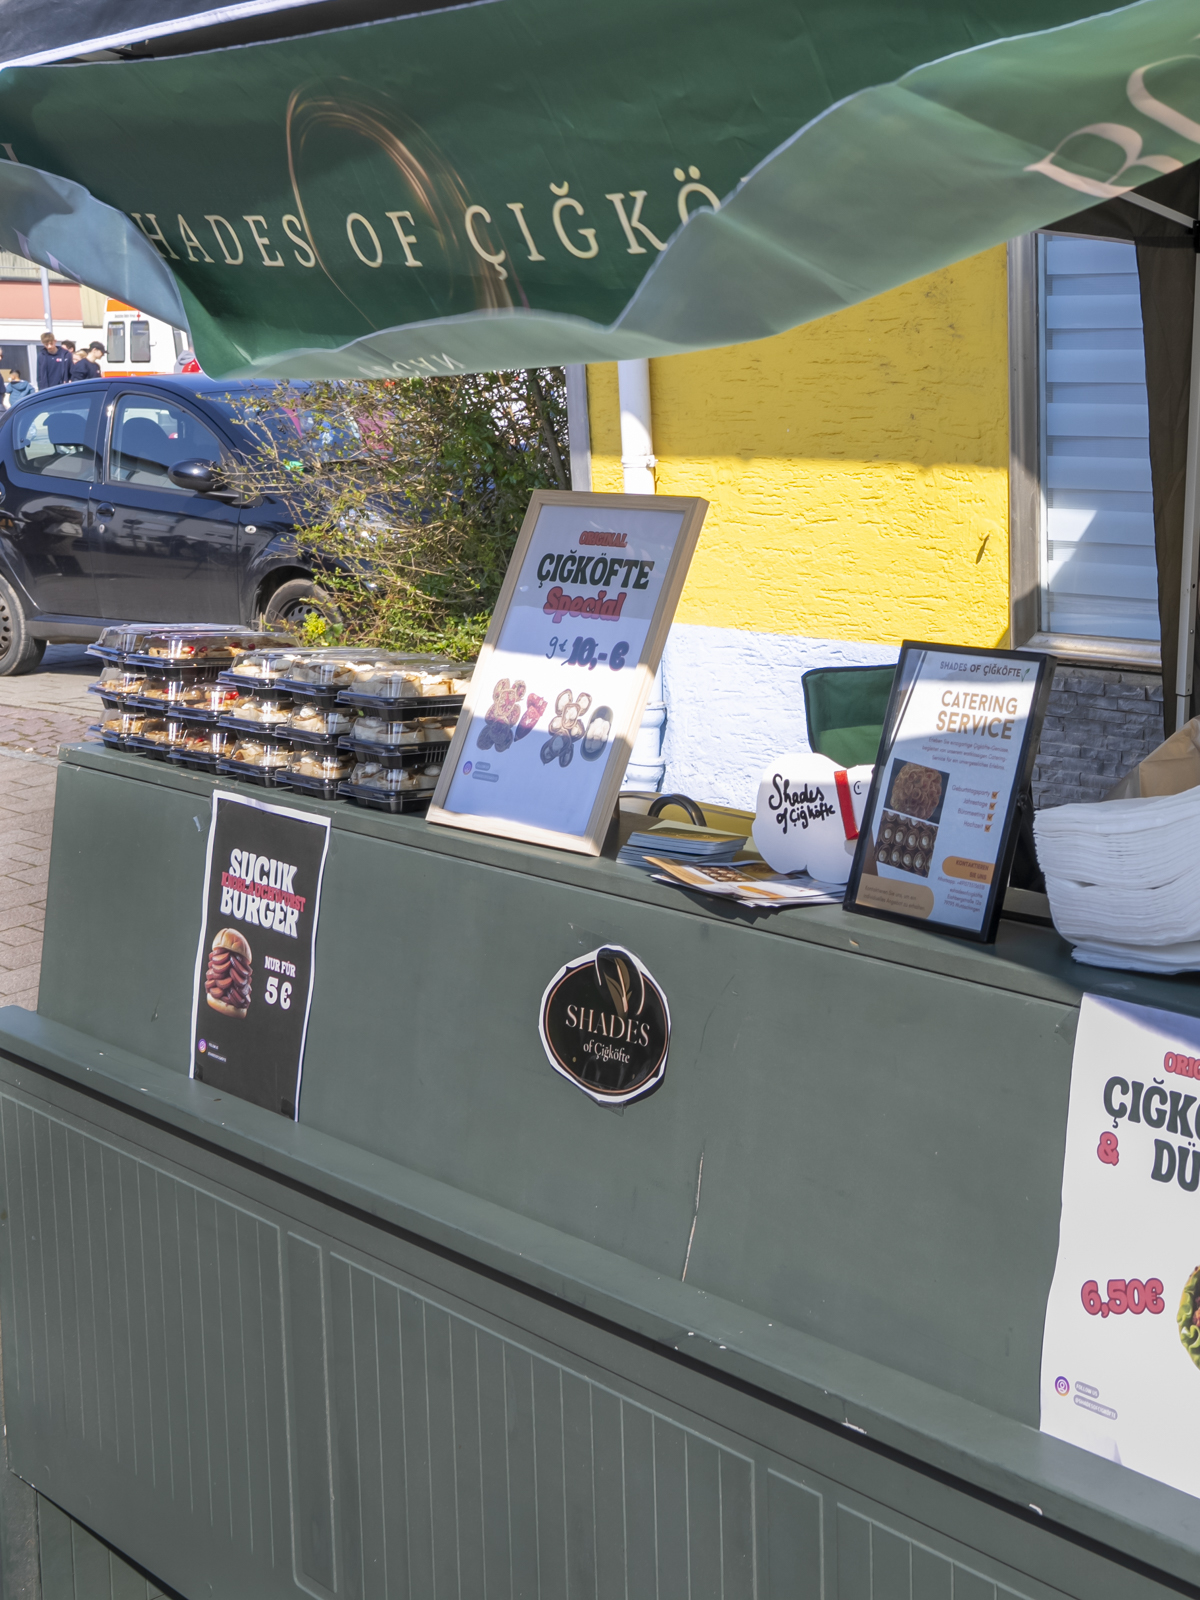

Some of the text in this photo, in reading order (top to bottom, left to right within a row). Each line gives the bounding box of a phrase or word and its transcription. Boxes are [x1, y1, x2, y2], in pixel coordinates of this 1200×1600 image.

[131, 165, 722, 280] HADES OF ÇIĞKÖ
[579, 531, 628, 547] ORIGINAL
[537, 550, 655, 590] ÇIĞKÖFTE
[543, 586, 627, 623] Special
[940, 661, 968, 672] SHADES
[969, 663, 982, 673] OF
[941, 690, 1018, 715] CATERING
[936, 710, 1015, 740] SERVICE
[768, 773, 825, 810] Shades
[776, 806, 788, 834] of
[229, 848, 298, 896] SUCUK
[221, 872, 306, 913] KNOBLAUCHWURST
[220, 886, 299, 939] BURGER
[264, 955, 296, 978] NUR FÜR
[565, 1004, 650, 1047] SHADES
[583, 1039, 594, 1052] of
[1097, 1131, 1120, 1167] &
[1080, 1277, 1166, 1319] 6,50€
